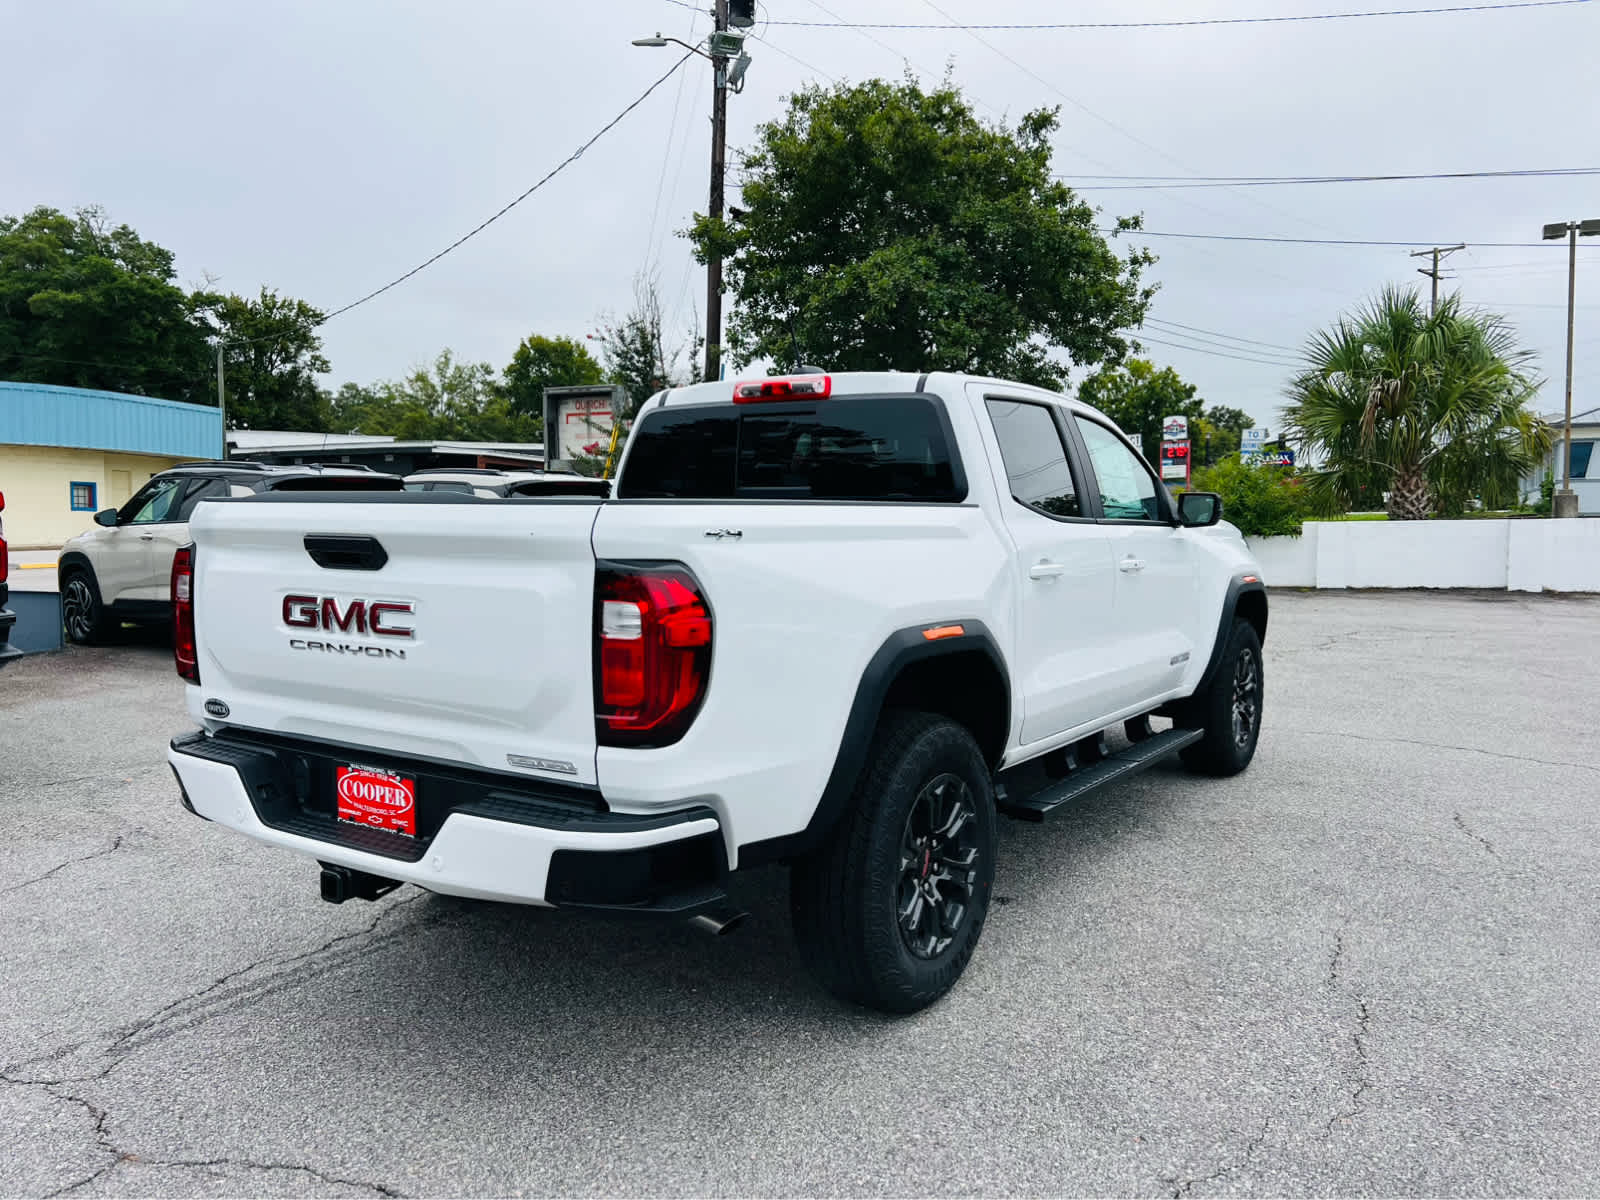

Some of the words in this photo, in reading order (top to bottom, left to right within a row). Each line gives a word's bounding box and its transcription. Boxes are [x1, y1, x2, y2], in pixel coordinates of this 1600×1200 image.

[282, 594, 415, 640] GMC
[290, 639, 407, 660] CANYON
[342, 778, 406, 807] COOPER
